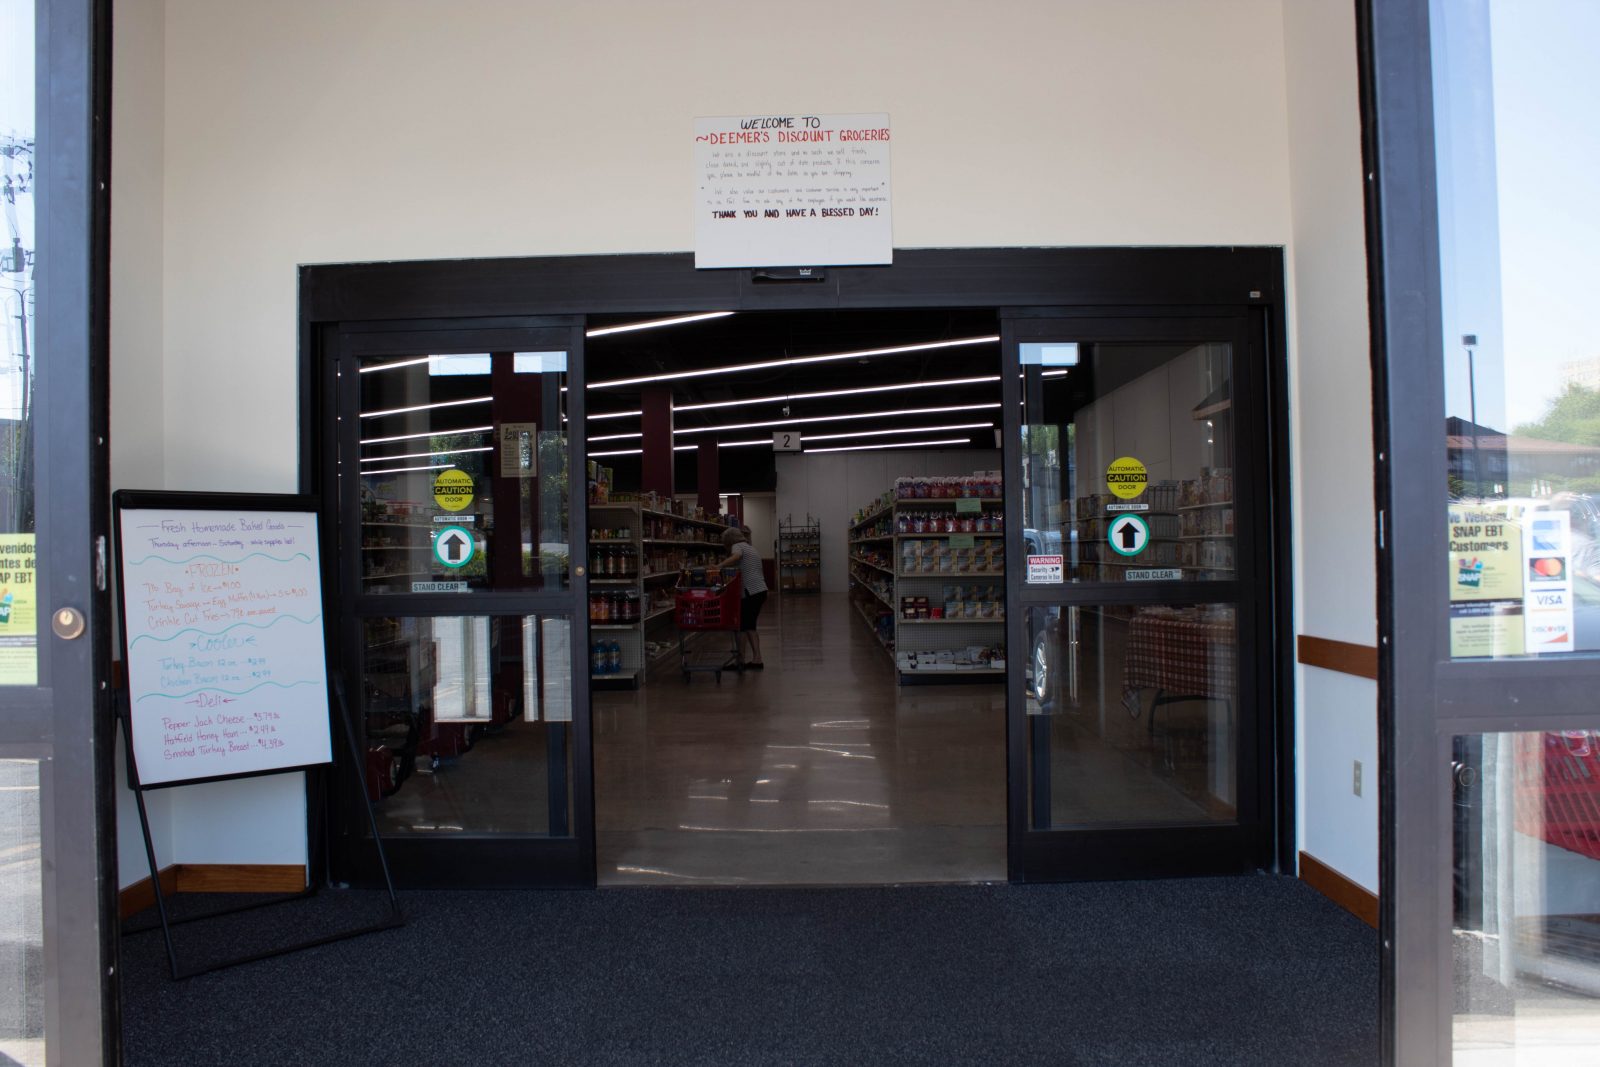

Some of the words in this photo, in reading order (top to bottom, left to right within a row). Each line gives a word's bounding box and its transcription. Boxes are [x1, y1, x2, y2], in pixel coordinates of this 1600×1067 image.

[740, 118, 795, 130] WELCOME
[802, 116, 821, 129] TO
[778, 130, 834, 143] DISCOUNT
[839, 128, 890, 142] GROCERIES
[712, 210, 736, 219] THANK
[743, 209, 758, 218] YOU
[764, 208, 779, 218] AND
[786, 208, 806, 218] HAVE
[810, 207, 817, 217] A
[822, 206, 855, 218] BLESSED
[782, 433, 792, 448] 2
[1108, 465, 1145, 473] AUTOMATIC
[435, 478, 471, 486] AUTOMATIC
[1107, 474, 1147, 483] CAUTION
[434, 486, 473, 495] CAUTION
[161, 519, 187, 534] Fresh
[191, 521, 236, 533] Homemade
[239, 518, 263, 532] Baked
[265, 518, 285, 530] Goods
[1453, 525, 1481, 538] SNAP
[1485, 525, 1504, 537] EBT
[148, 536, 180, 550] Thursday
[1449, 540, 1509, 552] Customers
[1029, 556, 1061, 565] WARNING
[1030, 566, 1048, 574] Security
[1127, 571, 1150, 580] STAND
[1151, 570, 1174, 579] CLEAR
[14, 572, 33, 584] EBT
[413, 583, 436, 592] STAND
[437, 582, 459, 591] CLEAR
[1537, 595, 1563, 606] VISA
[1532, 625, 1566, 634] DISCOVER
[158, 656, 186, 674] Turkey
[188, 655, 214, 669] Bacon
[199, 692, 222, 708] Deli
[161, 716, 191, 731] Pepper
[193, 715, 214, 728] Jack
[216, 713, 246, 725] Cheese
[196, 731, 220, 744] Honey
[163, 747, 196, 761] Smoked
[199, 744, 226, 758] Turkey
[228, 741, 251, 753] Breast
